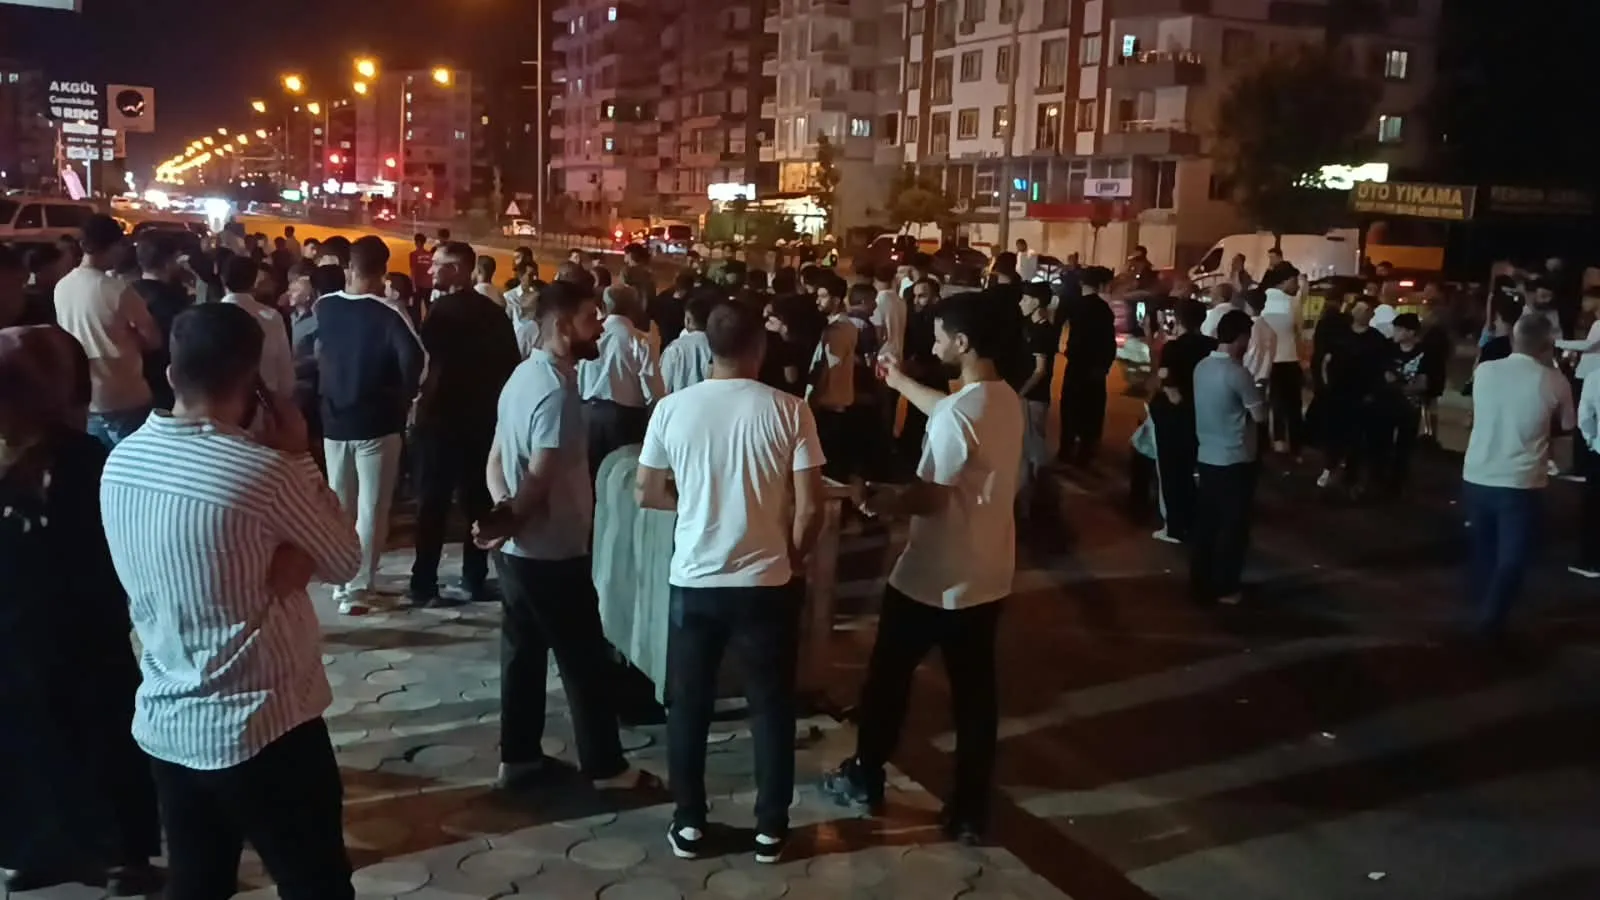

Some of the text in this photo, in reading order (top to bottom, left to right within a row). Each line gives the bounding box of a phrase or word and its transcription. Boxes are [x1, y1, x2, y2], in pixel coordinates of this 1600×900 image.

[49, 80, 98, 95] AKGÜL
[1358, 183, 1463, 206] OTO YIKAMA
